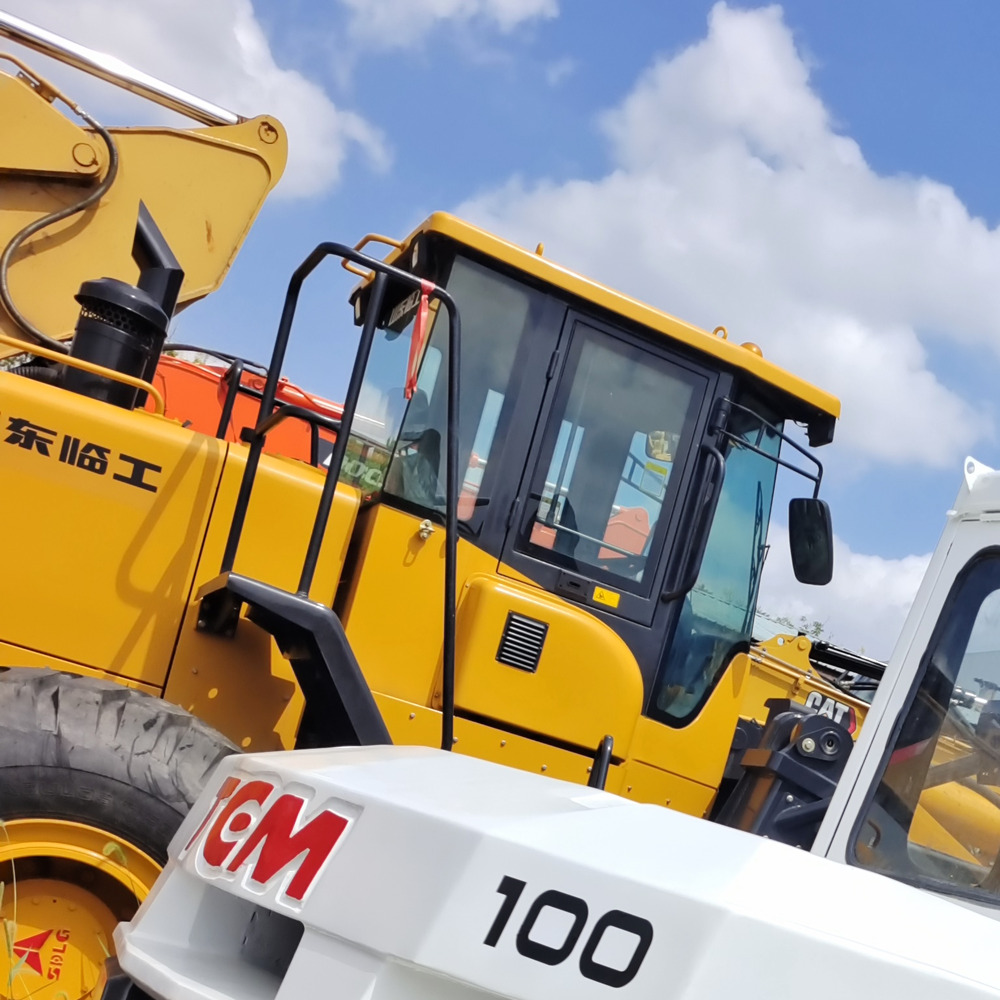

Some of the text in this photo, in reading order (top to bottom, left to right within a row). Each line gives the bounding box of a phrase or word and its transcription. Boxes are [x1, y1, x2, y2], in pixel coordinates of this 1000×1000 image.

[4, 416, 163, 493] 东临工
[805, 690, 850, 725] CAT
[184, 776, 350, 901] TCM
[47, 928, 71, 981] SDLG
[483, 874, 654, 989] 100
